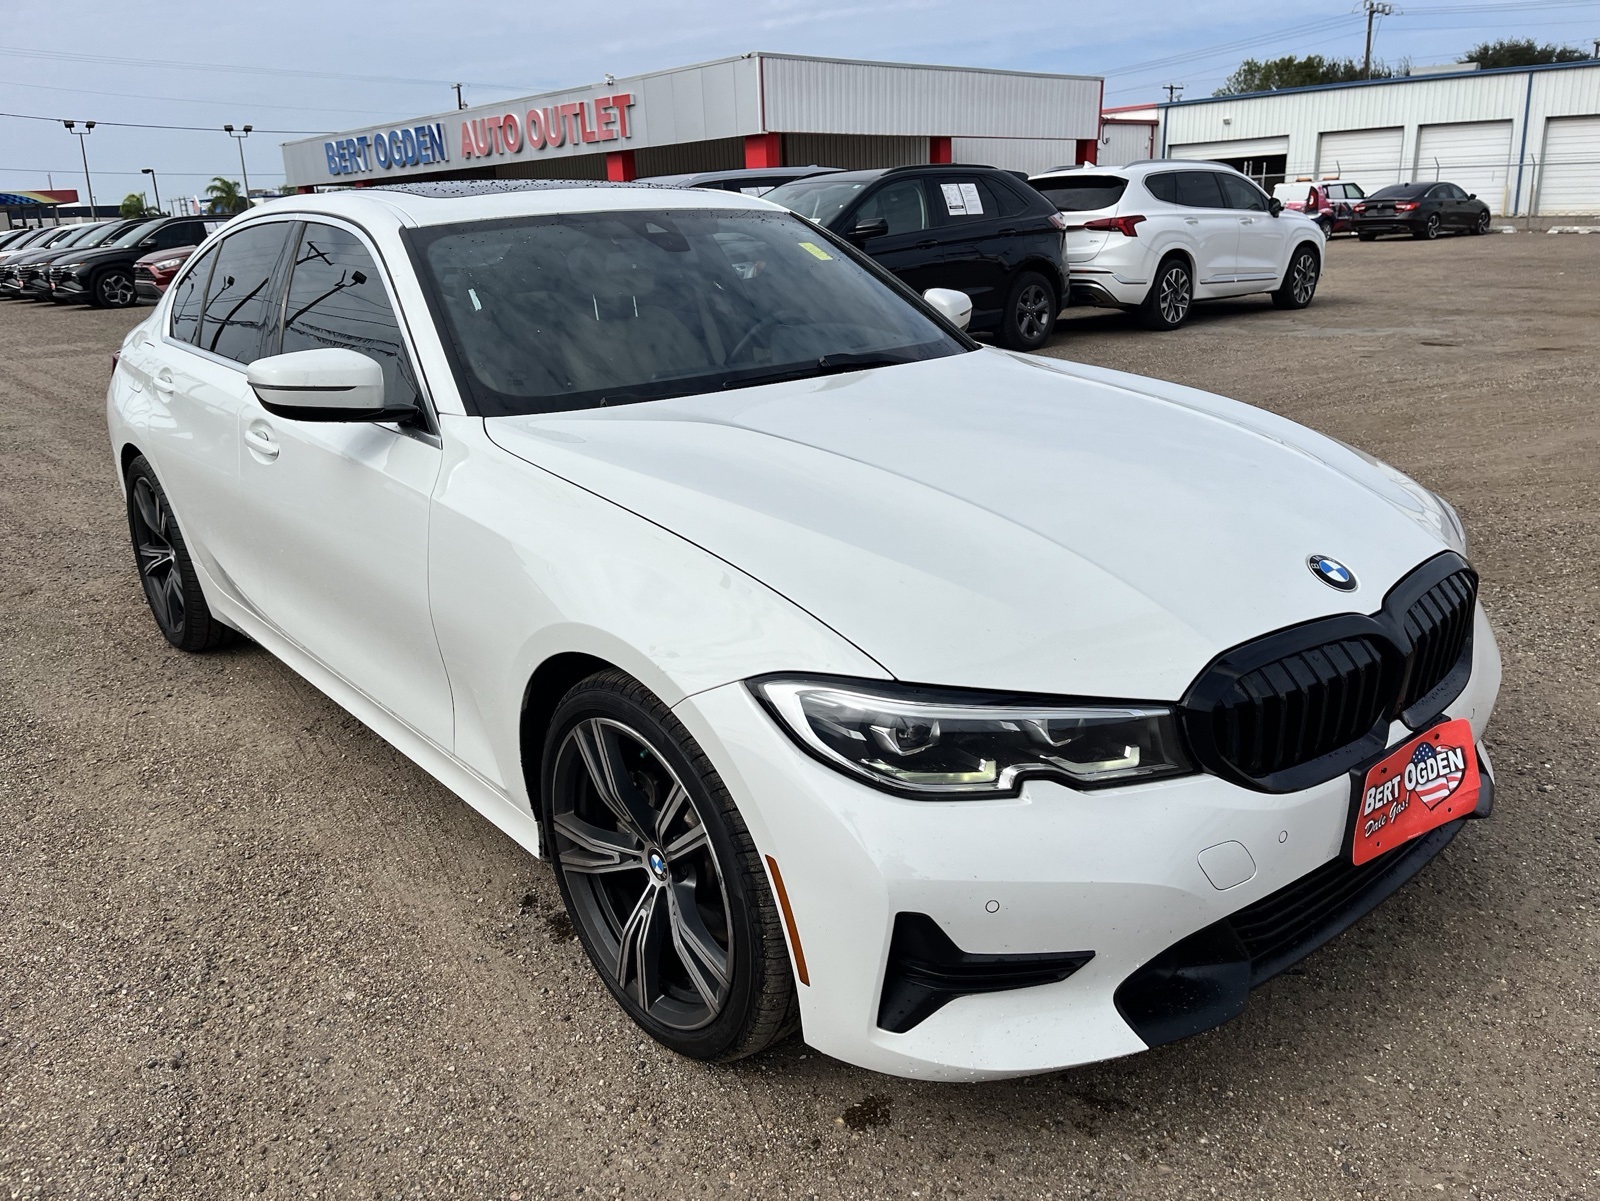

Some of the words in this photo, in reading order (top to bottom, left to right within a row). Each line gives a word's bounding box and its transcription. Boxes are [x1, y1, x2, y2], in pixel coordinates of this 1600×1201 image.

[325, 135, 372, 176] BERT
[374, 123, 448, 169] OGDEN
[461, 113, 523, 159] AUTO
[526, 94, 635, 149] OUTLET
[1364, 775, 1401, 816] BERT
[1404, 748, 1465, 790] OGDEN
[1389, 792, 1409, 823] Gas!
